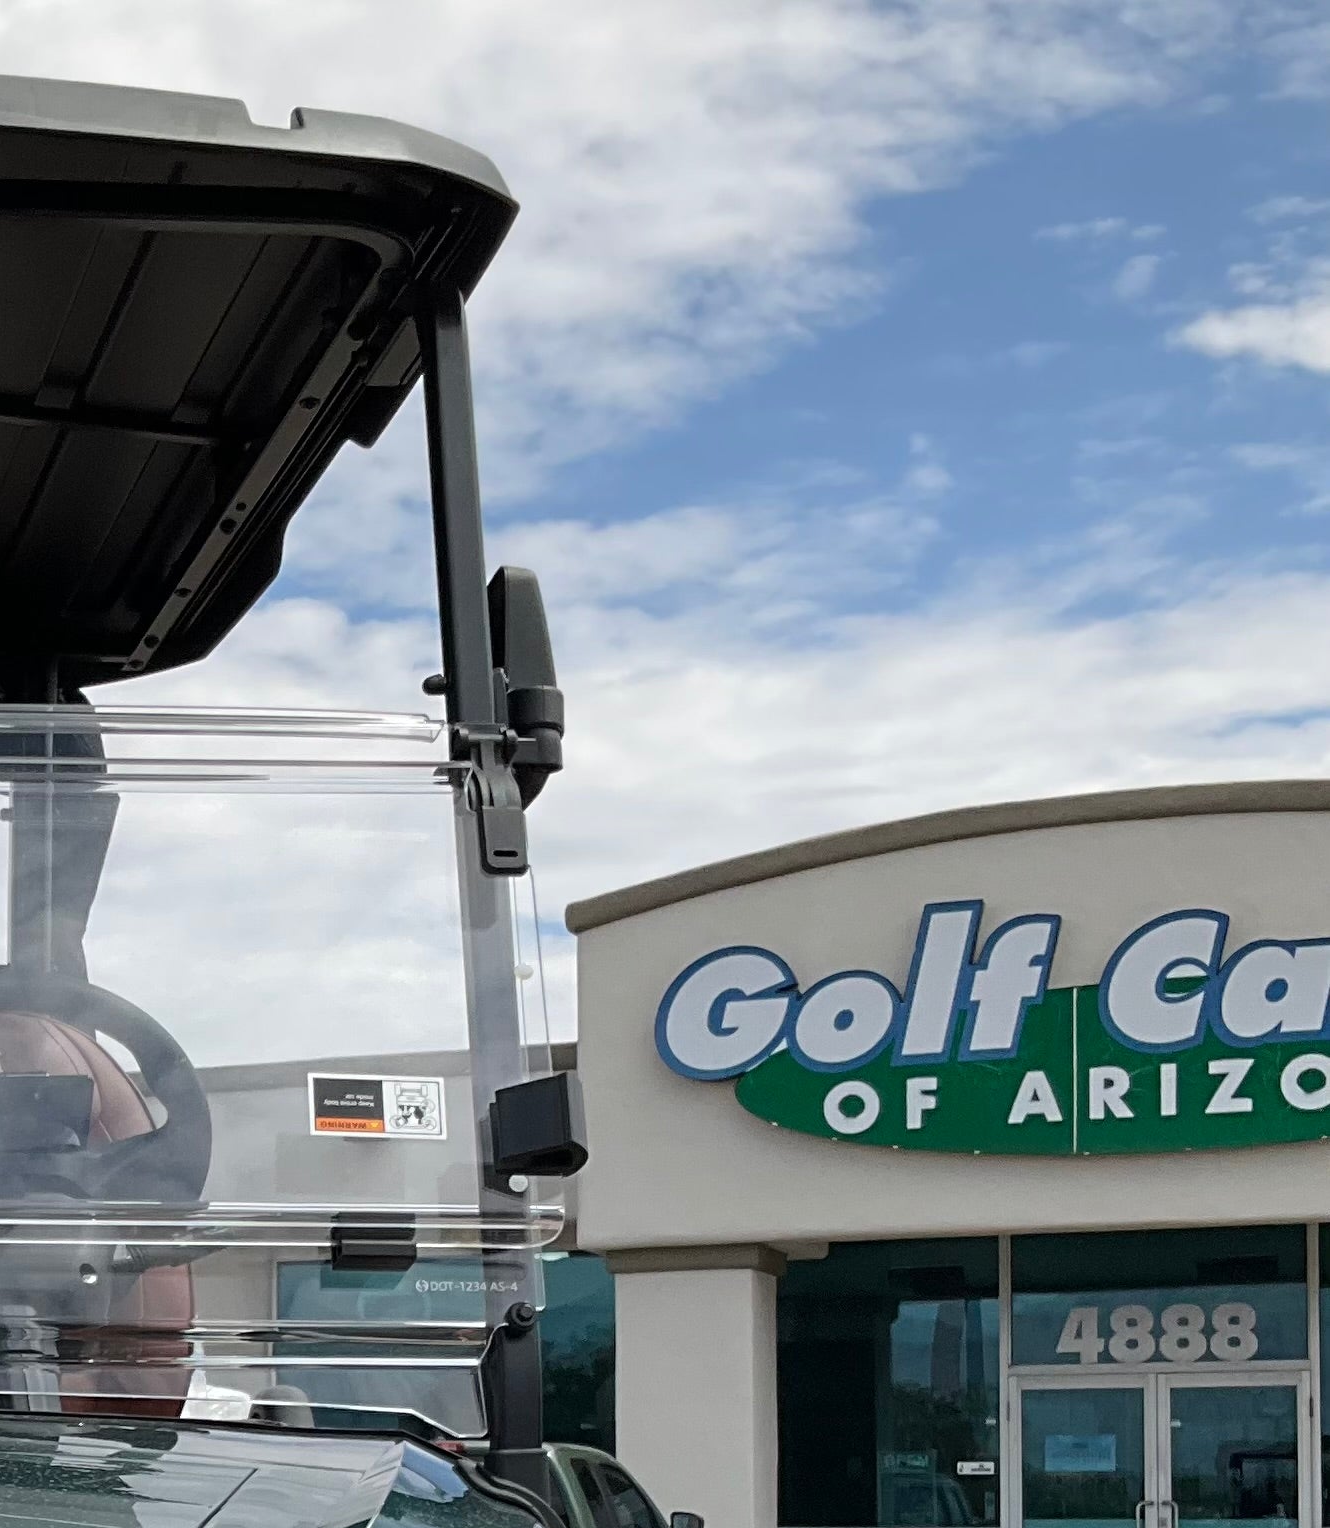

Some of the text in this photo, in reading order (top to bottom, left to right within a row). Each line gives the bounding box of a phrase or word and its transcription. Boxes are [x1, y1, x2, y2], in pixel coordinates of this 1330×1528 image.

[656, 900, 1061, 1080] Golf
[320, 1121, 367, 1129] WARNING
[823, 1076, 938, 1133] OF
[430, 1281, 518, 1292] DOT-1234 AS-4
[1056, 1302, 1259, 1364] 4888
